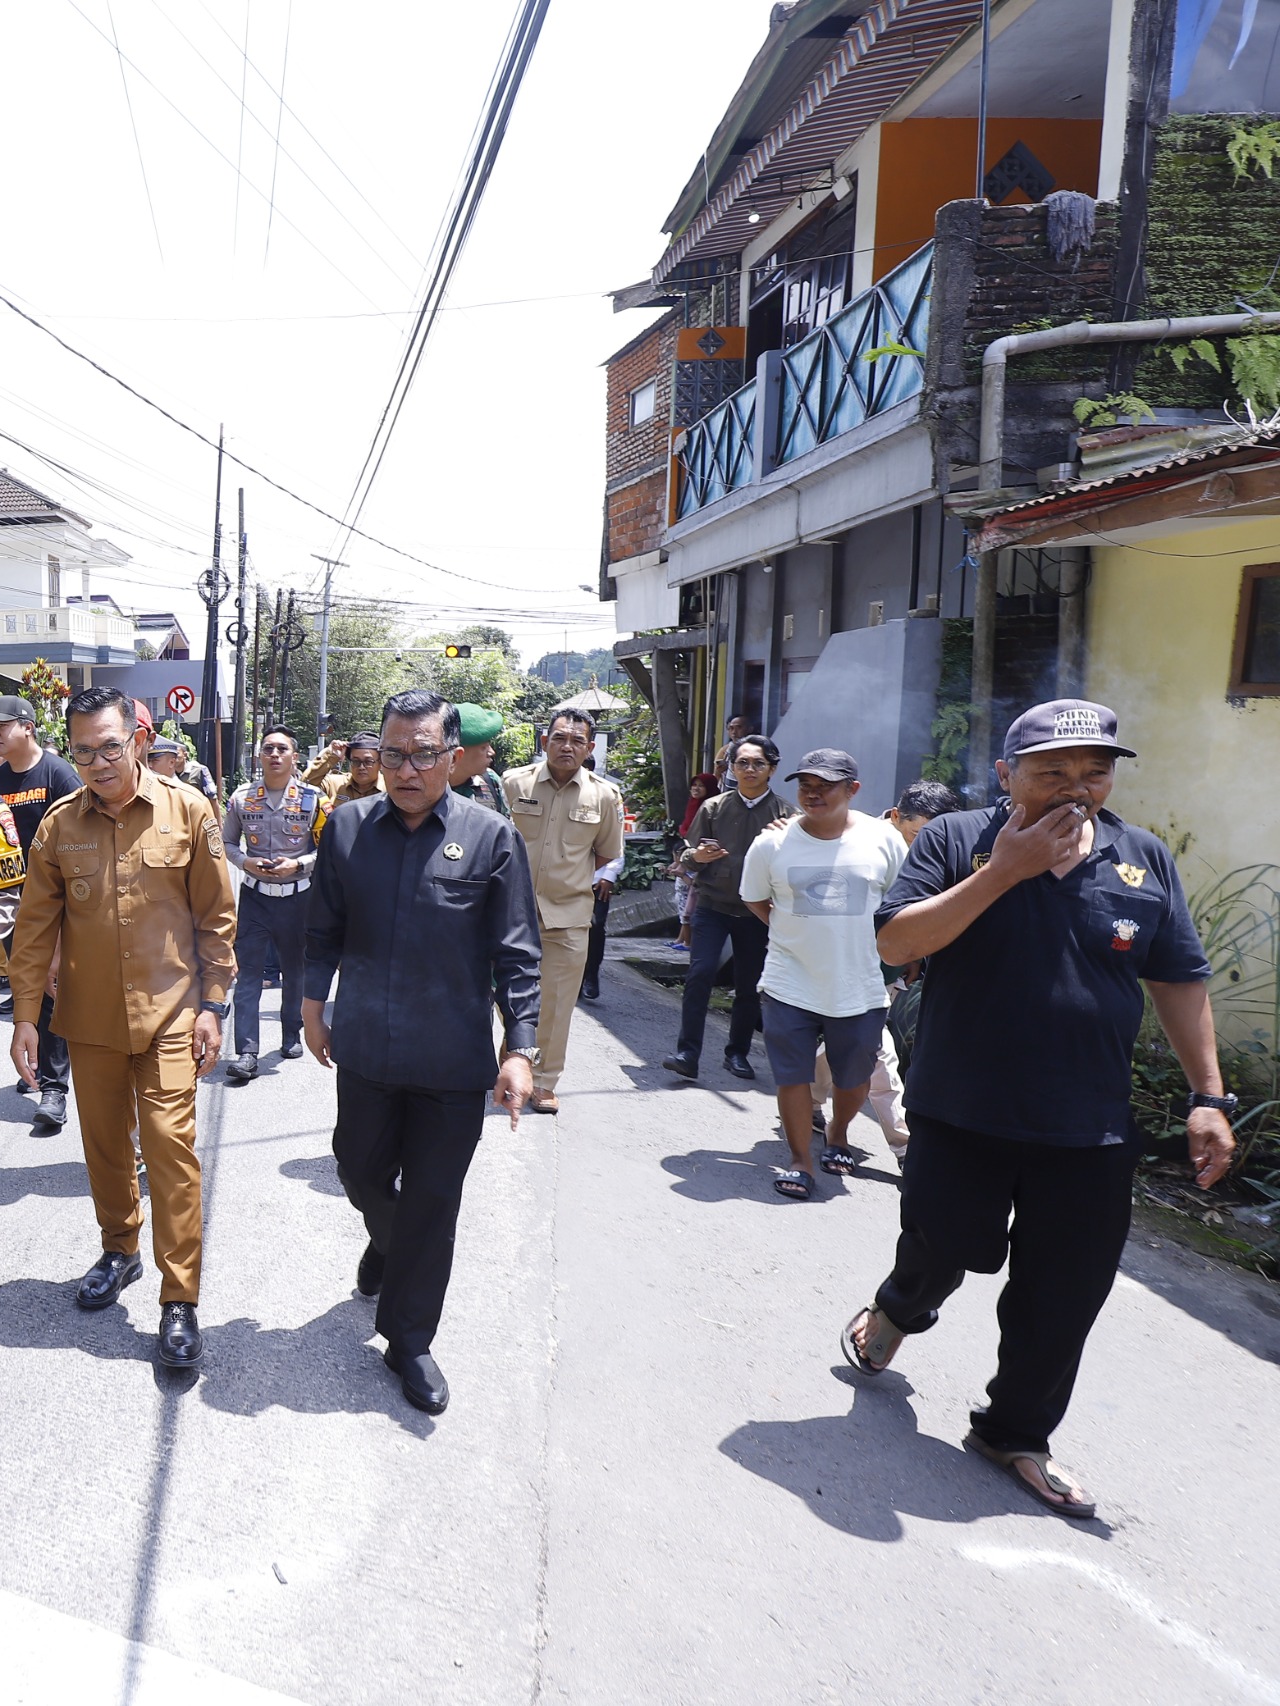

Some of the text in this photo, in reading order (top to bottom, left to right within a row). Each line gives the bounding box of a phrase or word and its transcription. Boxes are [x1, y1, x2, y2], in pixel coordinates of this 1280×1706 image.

[1056, 710, 1097, 722] PUNK
[1057, 727, 1100, 737] ADVISORY
[242, 813, 264, 821] KEVIN
[284, 814, 309, 822] POLRI
[57, 842, 98, 852] NUROCHMAN
